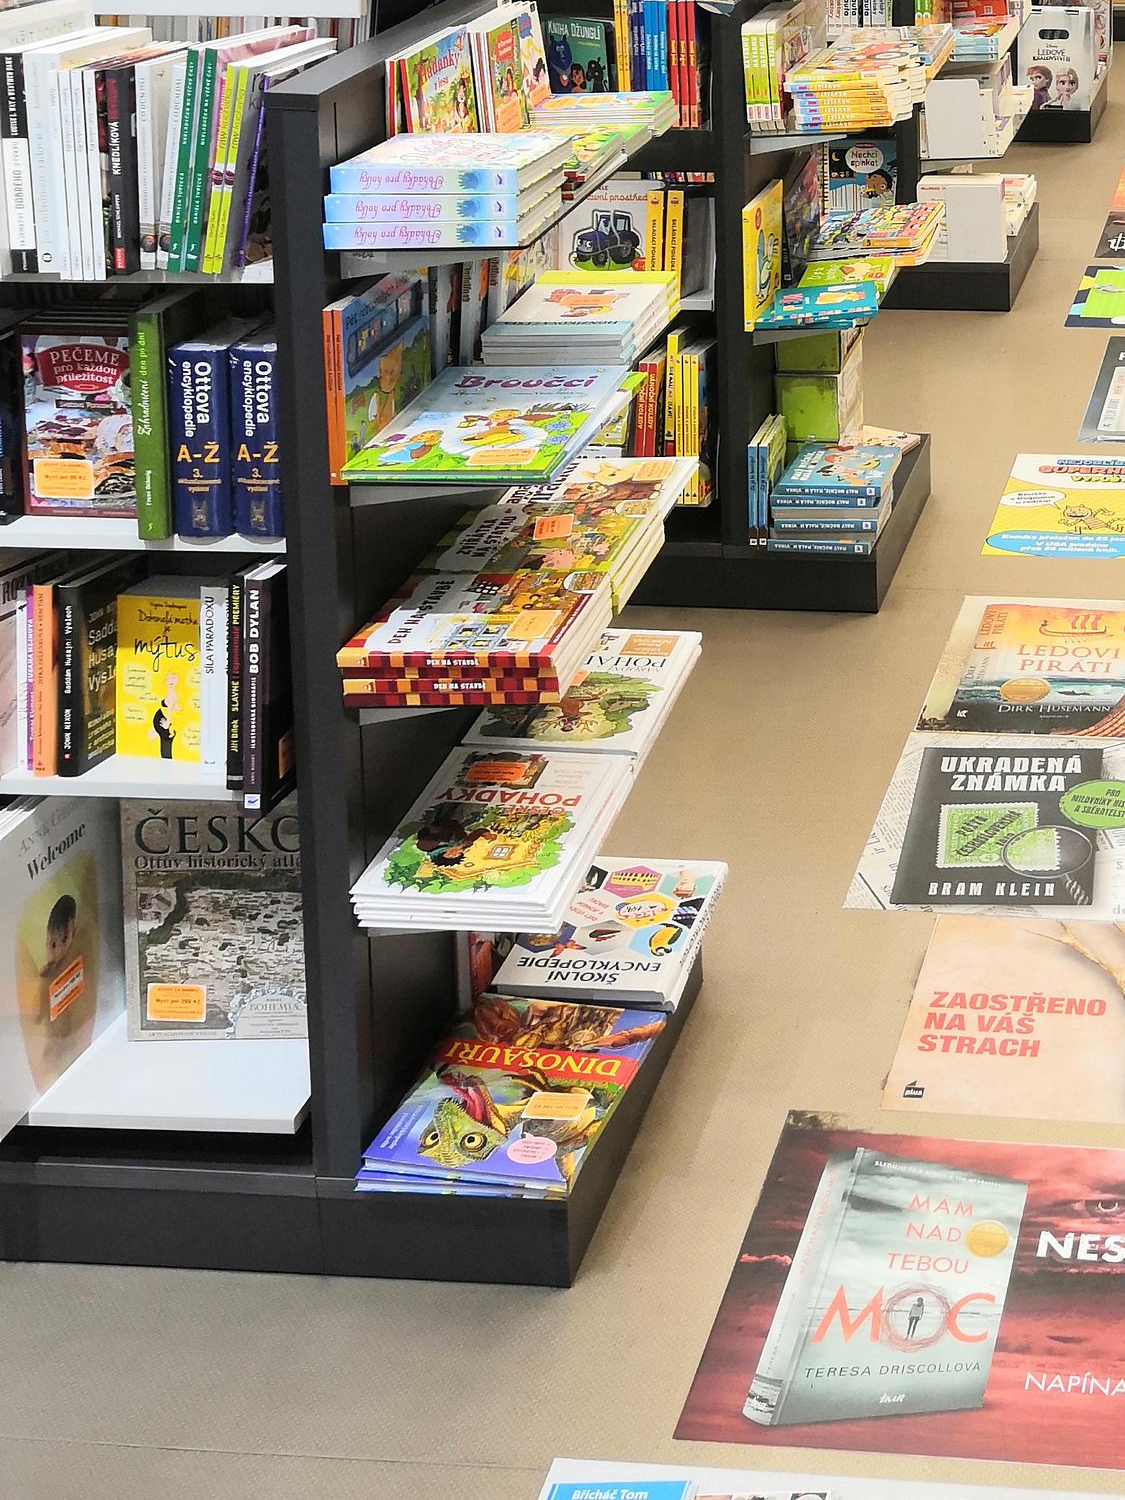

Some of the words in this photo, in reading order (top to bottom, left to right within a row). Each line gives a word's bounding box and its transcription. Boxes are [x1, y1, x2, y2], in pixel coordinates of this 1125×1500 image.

[548, 20, 569, 36] KNIHA
[571, 18, 601, 39] DŽUNGLÍ
[851, 150, 878, 160] Nechci
[851, 158, 879, 168] spinkat
[50, 346, 120, 366] PEČEME
[53, 364, 74, 375] pro
[195, 361, 212, 424] Ottova
[256, 361, 272, 424] Ottova
[454, 374, 599, 390] Broučci
[243, 361, 253, 437] encyklopedie
[177, 442, 220, 463] A-Ž
[237, 442, 279, 463] A-Ž
[206, 596, 214, 649] PARADOXU
[250, 589, 259, 639] DYLAN
[134, 634, 196, 672] mýtus
[250, 644, 259, 674] BOB
[1018, 644, 1121, 660] LEDOVÍ
[206, 652, 214, 674] SÍLA
[1019, 658, 1113, 674] PIRÁTI
[998, 703, 1034, 714] DIRK
[1038, 704, 1112, 714] HUSEMANN
[941, 754, 1082, 775] UKRADENÁ
[950, 771, 1067, 793] ZNÁMKA
[1104, 789, 1121, 798] PRO
[135, 808, 300, 854] ČESKO
[135, 855, 185, 869] Ottův
[188, 855, 269, 869] historický
[928, 882, 983, 896] BRAM
[995, 882, 1056, 897] KLEIN
[517, 956, 662, 973] ENCYKLOPEDIE
[547, 970, 619, 987] ŠKOLNÍ
[928, 991, 1107, 1017] ZAOSTŘENO
[923, 1012, 972, 1031] NA
[977, 1012, 1035, 1034] VÁŠ
[917, 1034, 1041, 1058] STRACH
[907, 1193, 974, 1217] MÁM
[904, 1222, 961, 1243] NAD
[886, 1252, 969, 1275] TEBOU
[811, 1283, 995, 1353] MOC
[804, 1366, 872, 1379] TERESA
[879, 1361, 981, 1376] DRISCOLLOVÁ
[571, 1489, 618, 1500] Břicháč
[620, 1489, 648, 1500] Tom
